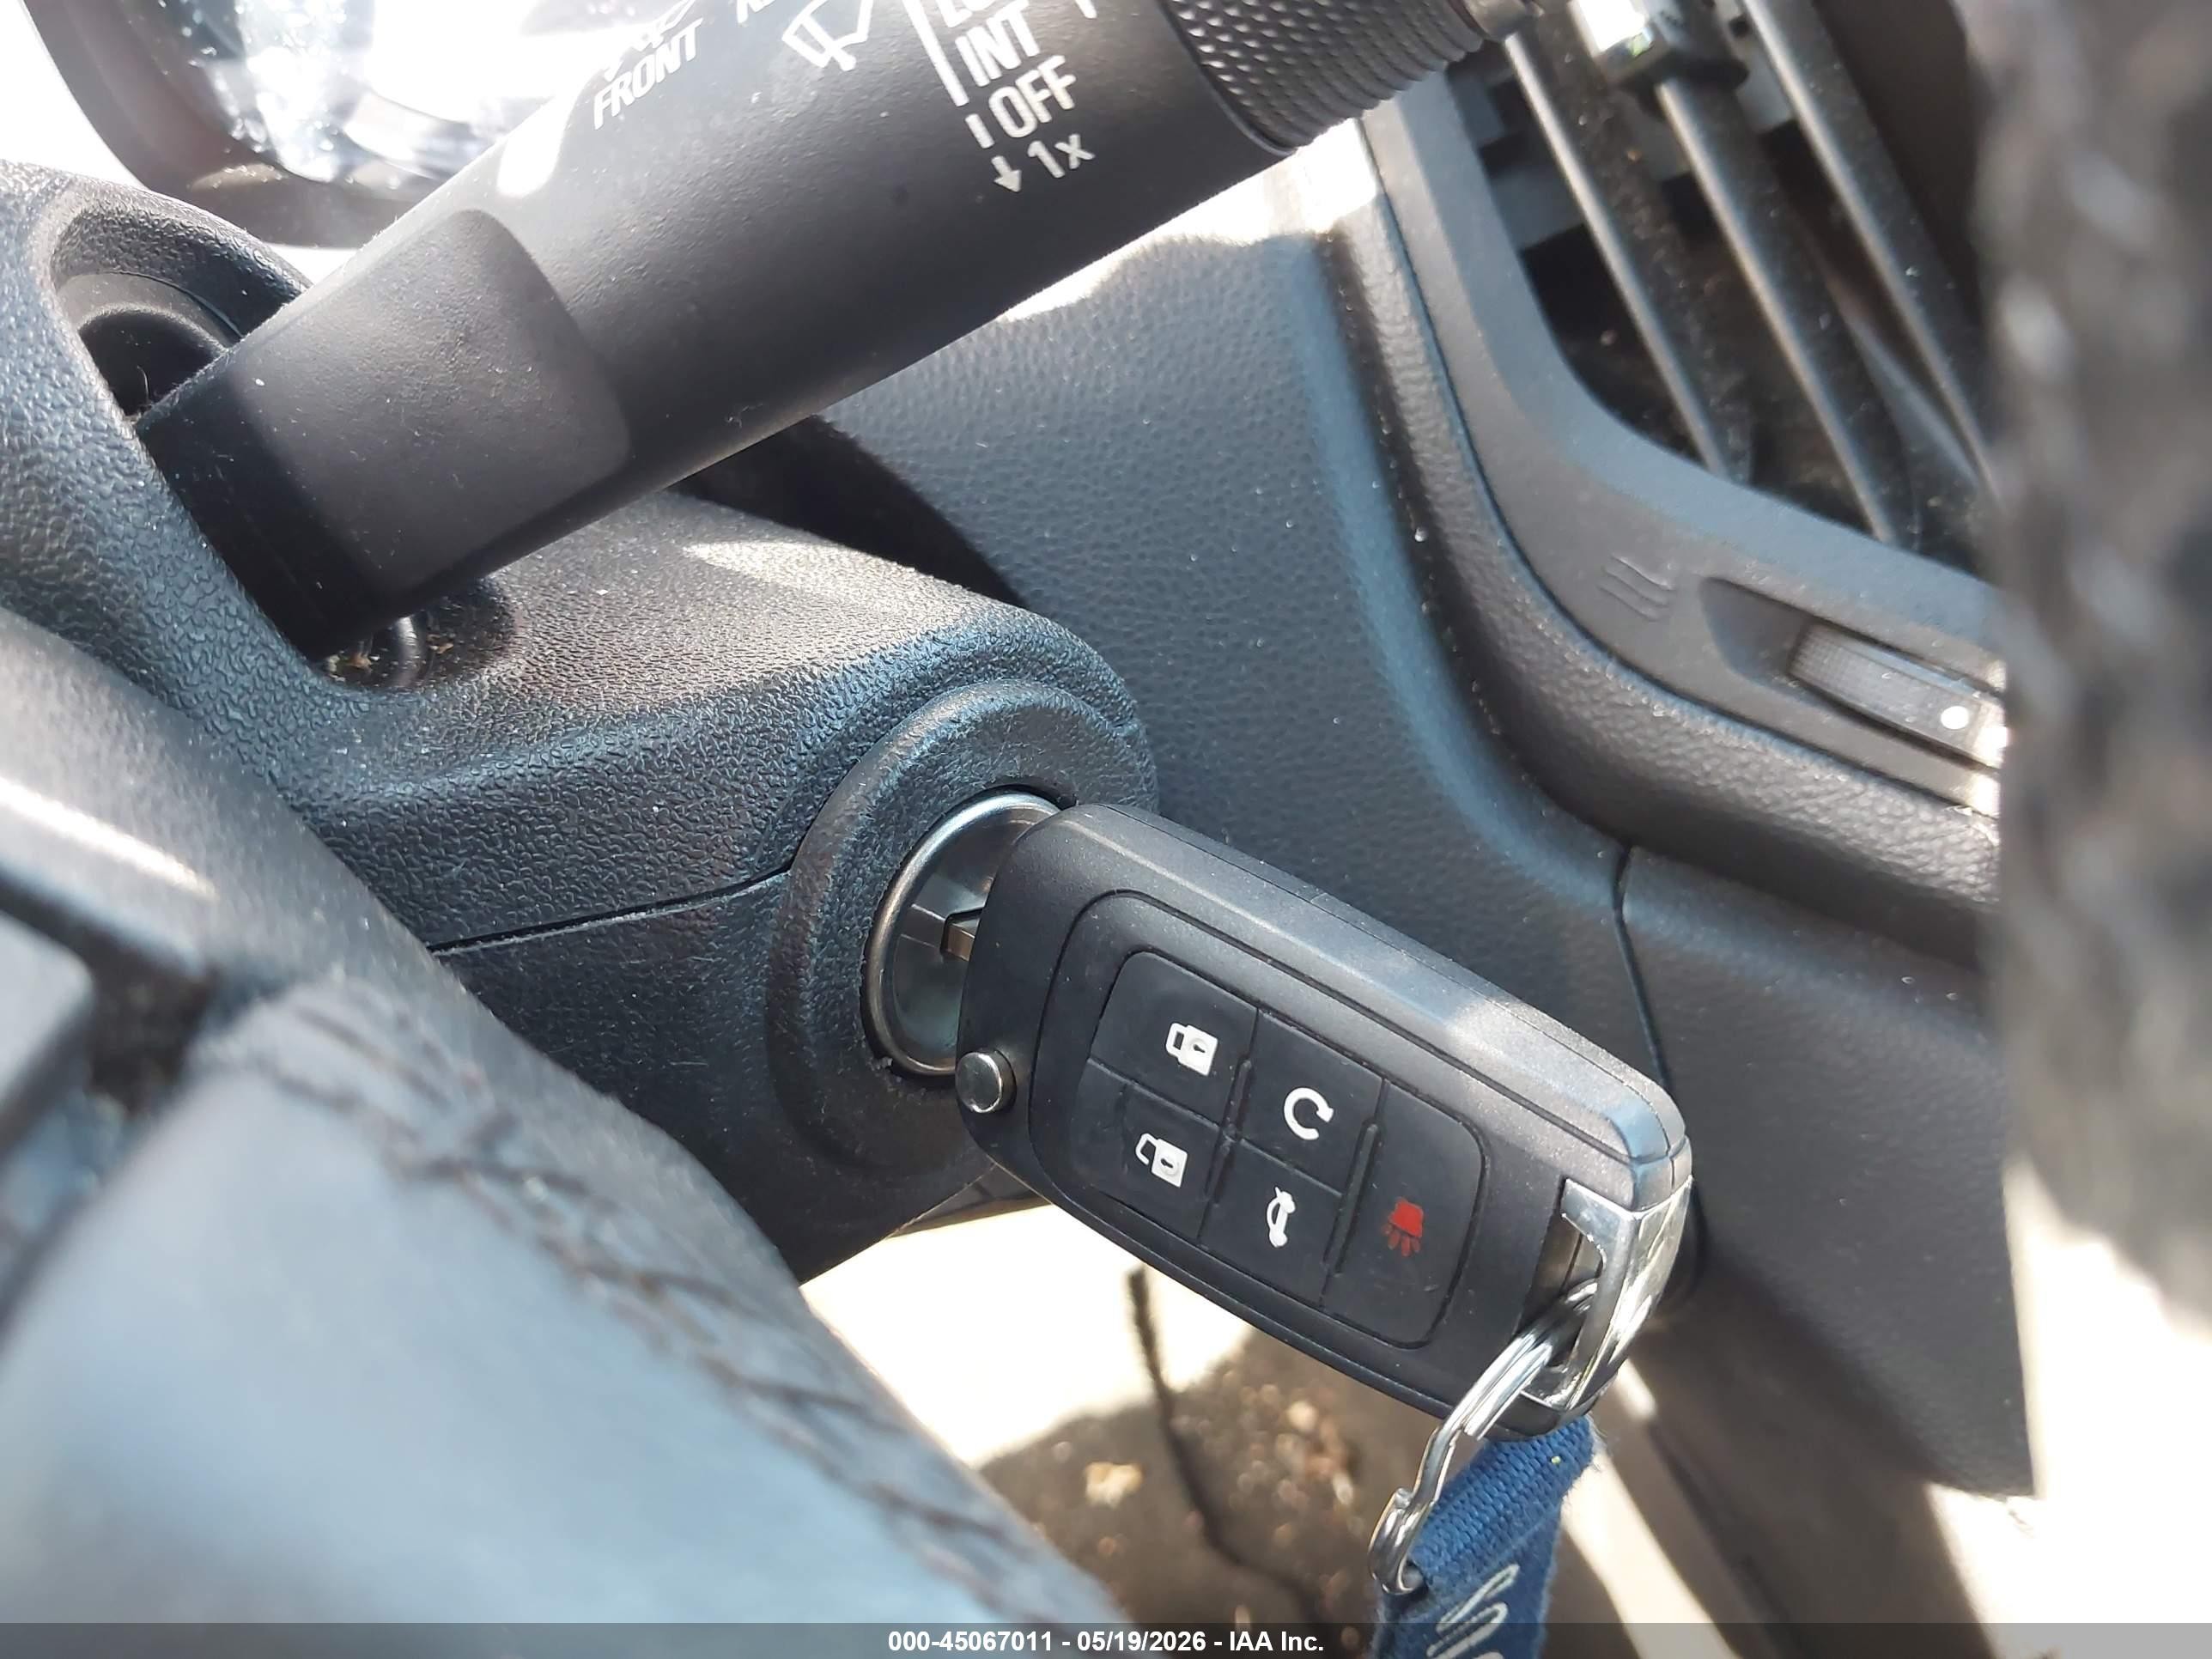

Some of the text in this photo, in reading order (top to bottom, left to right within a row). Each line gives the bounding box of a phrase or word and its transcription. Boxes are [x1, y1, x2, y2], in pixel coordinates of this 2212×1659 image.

[593, 17, 703, 130] FRONT
[955, 0, 1040, 87] INT
[988, 55, 1077, 138] OFF
[1027, 133, 1096, 179] 1x
